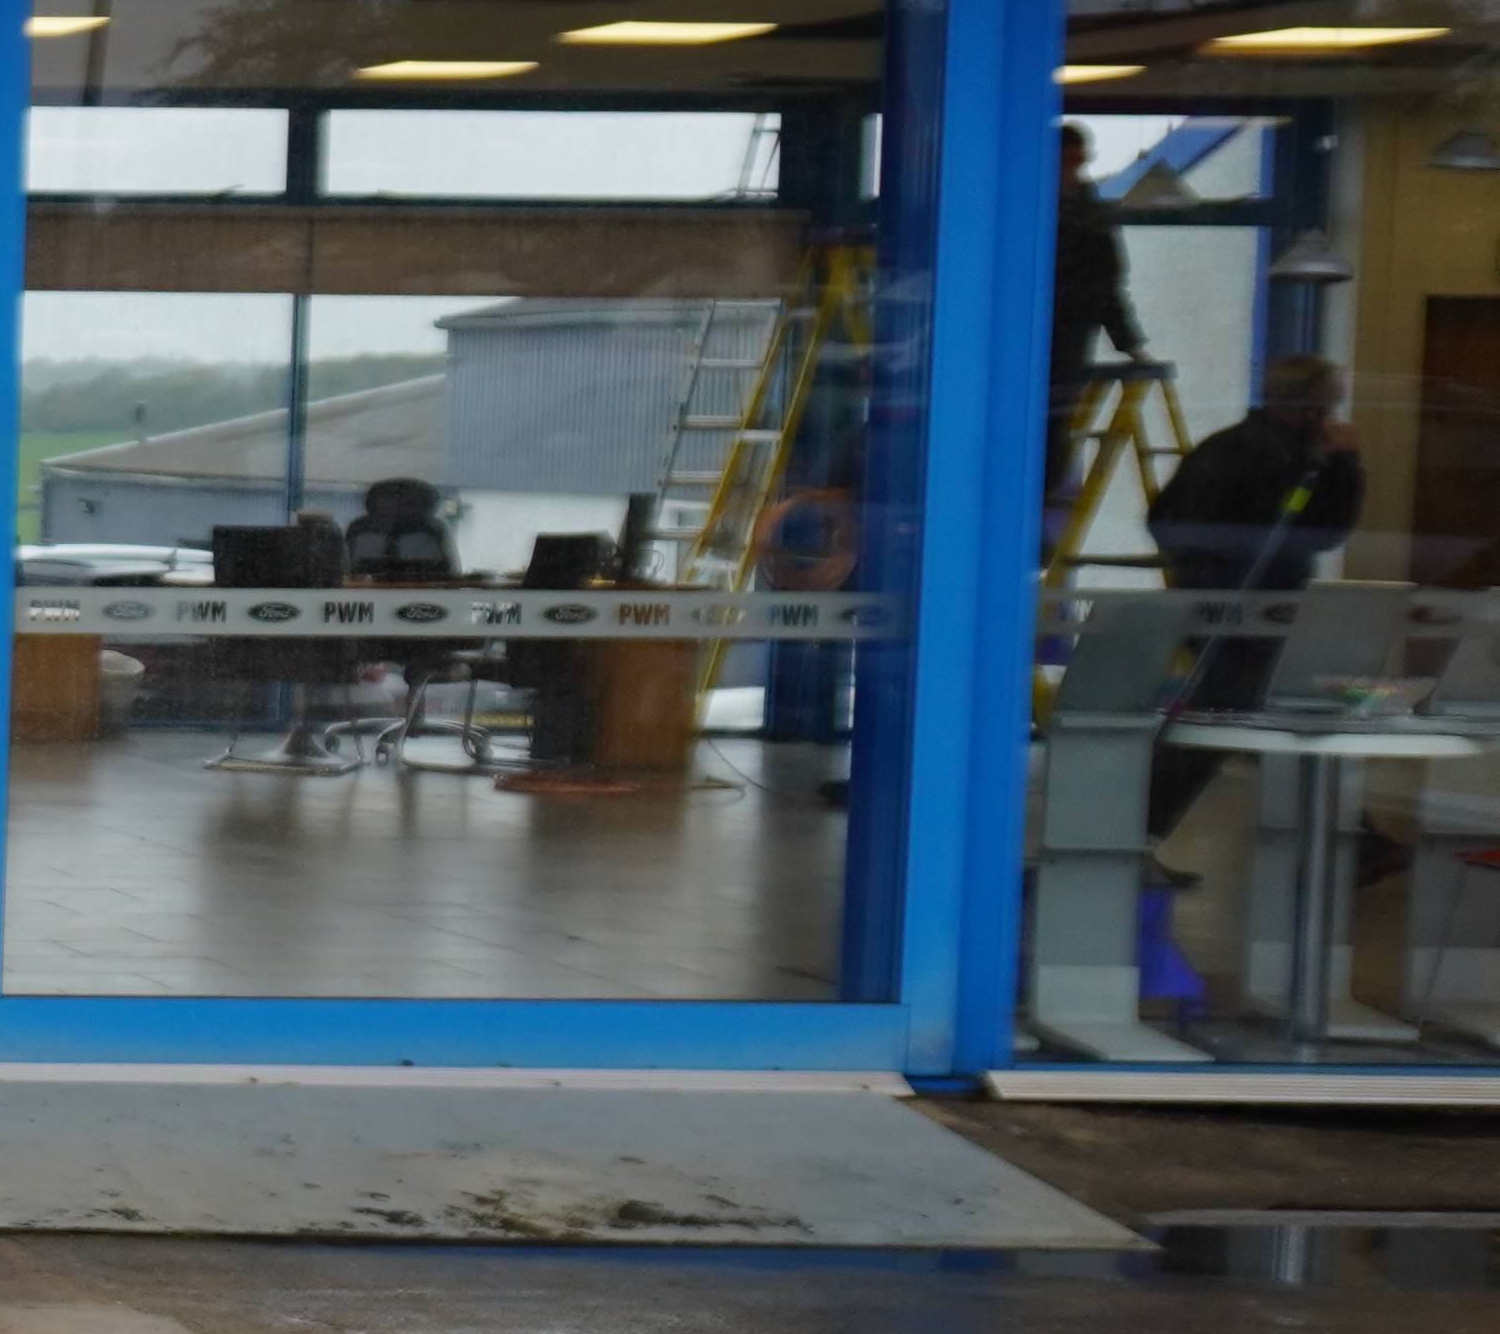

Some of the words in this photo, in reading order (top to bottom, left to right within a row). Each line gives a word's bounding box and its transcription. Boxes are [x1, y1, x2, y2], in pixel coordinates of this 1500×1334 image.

[177, 600, 227, 623] PWM
[323, 601, 375, 624] PWM
[619, 603, 671, 626] PWM
